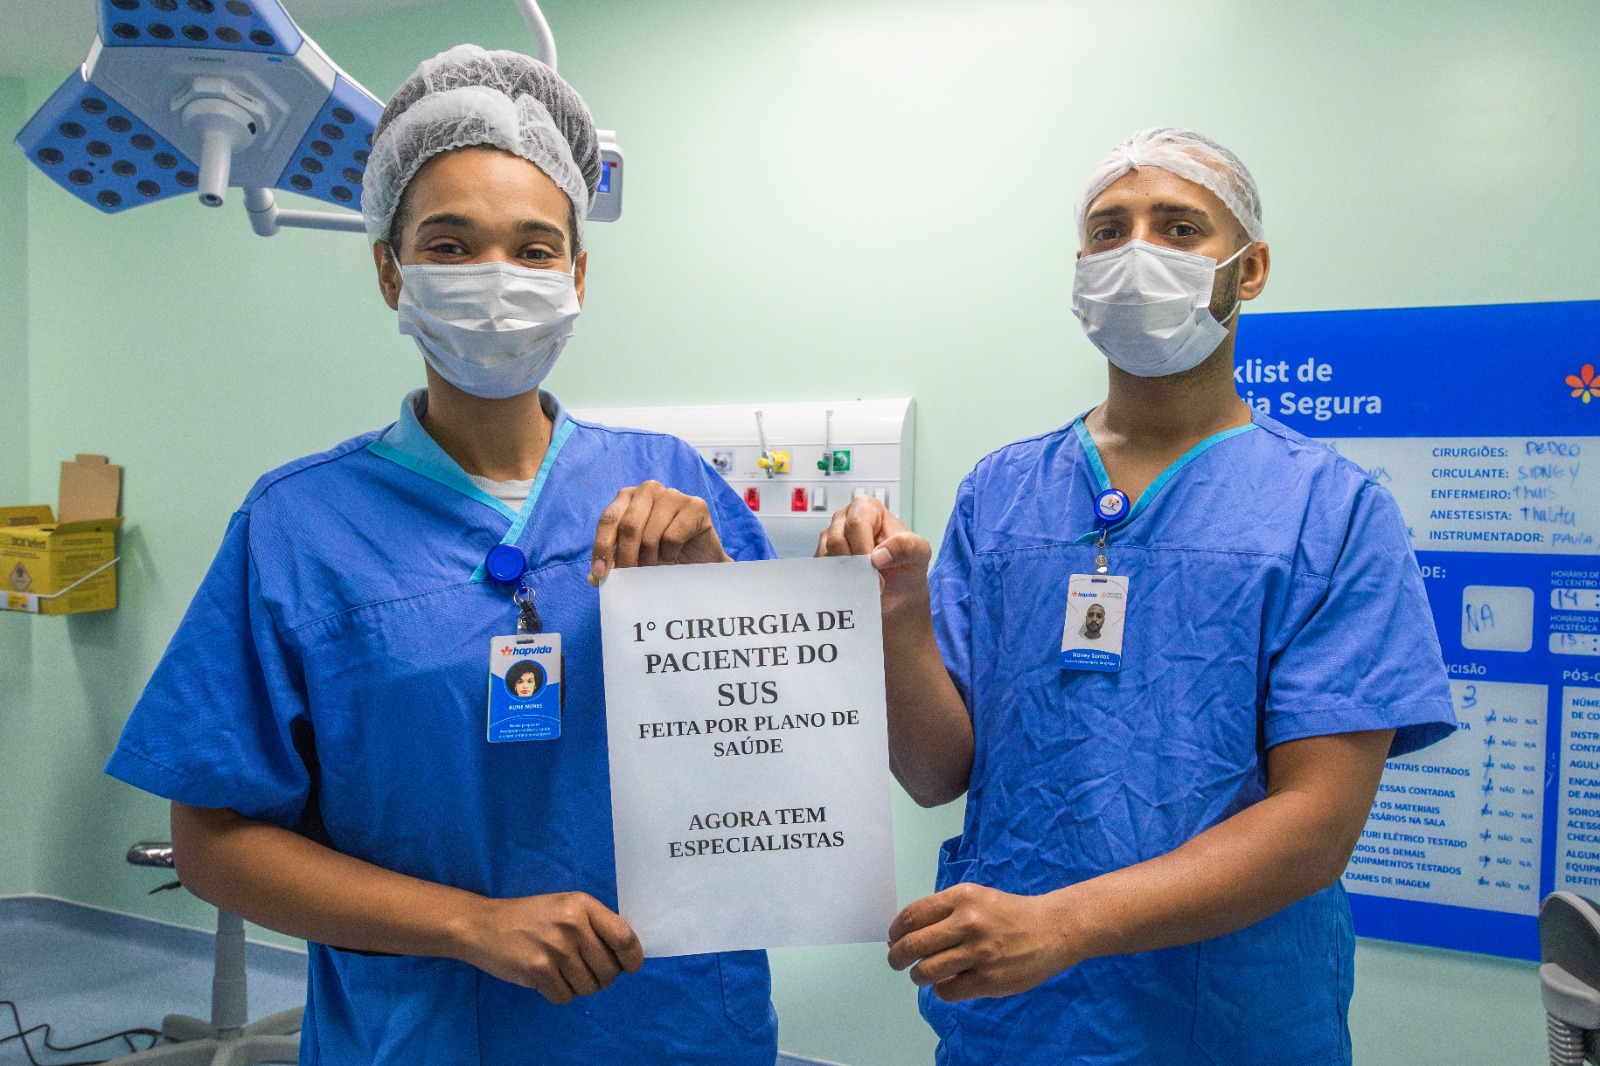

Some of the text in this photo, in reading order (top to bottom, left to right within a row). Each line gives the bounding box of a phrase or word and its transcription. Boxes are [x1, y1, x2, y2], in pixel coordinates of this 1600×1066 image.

[1297, 357, 1333, 383] de
[1279, 391, 1382, 421] Segura
[1432, 445, 1509, 457] CIRURGIÕES:
[1431, 468, 1509, 479] CIRCULANTE:
[1431, 489, 1511, 500] ENFERMEIRO:
[1430, 510, 1512, 521] ANESTESISTA:
[1429, 531, 1544, 543] INSTRUMENTADOR:
[1551, 570, 1587, 579] HORÁRIO
[1466, 603, 1495, 633] NA
[1550, 615, 1587, 623] HORÁRIO
[665, 612, 811, 641] CIRURGIA
[816, 609, 856, 631] DE
[1550, 623, 1597, 632] ANESTÉSICA
[512, 646, 553, 656] hapvida
[645, 643, 839, 674] PACIENTE DO
[717, 680, 779, 707] SUS
[1571, 711, 1584, 719] DE
[638, 709, 860, 739] FEITA POR PLANO DE
[713, 736, 784, 757] SAÚDE
[1421, 765, 1471, 776] CONTADOS
[1408, 786, 1455, 798] CONTADAS
[1568, 790, 1581, 798] DE
[1380, 801, 1393, 809] OS
[1395, 803, 1440, 814] MATERIAIS
[688, 806, 827, 831] AGORA TEM
[1370, 811, 1446, 827] SSÁRIOS NA SALA
[668, 830, 846, 859] ESPECIALISTAS
[1383, 832, 1424, 844] ELÉTRICO
[1426, 837, 1468, 849] TESTADO
[1378, 846, 1391, 854] OS
[1393, 848, 1426, 859] DEMAIS
[1415, 862, 1462, 875] TESTADOS
[1345, 871, 1431, 889] EXAMES DE IMAGEM
[1565, 875, 1600, 886] DEFEIT
